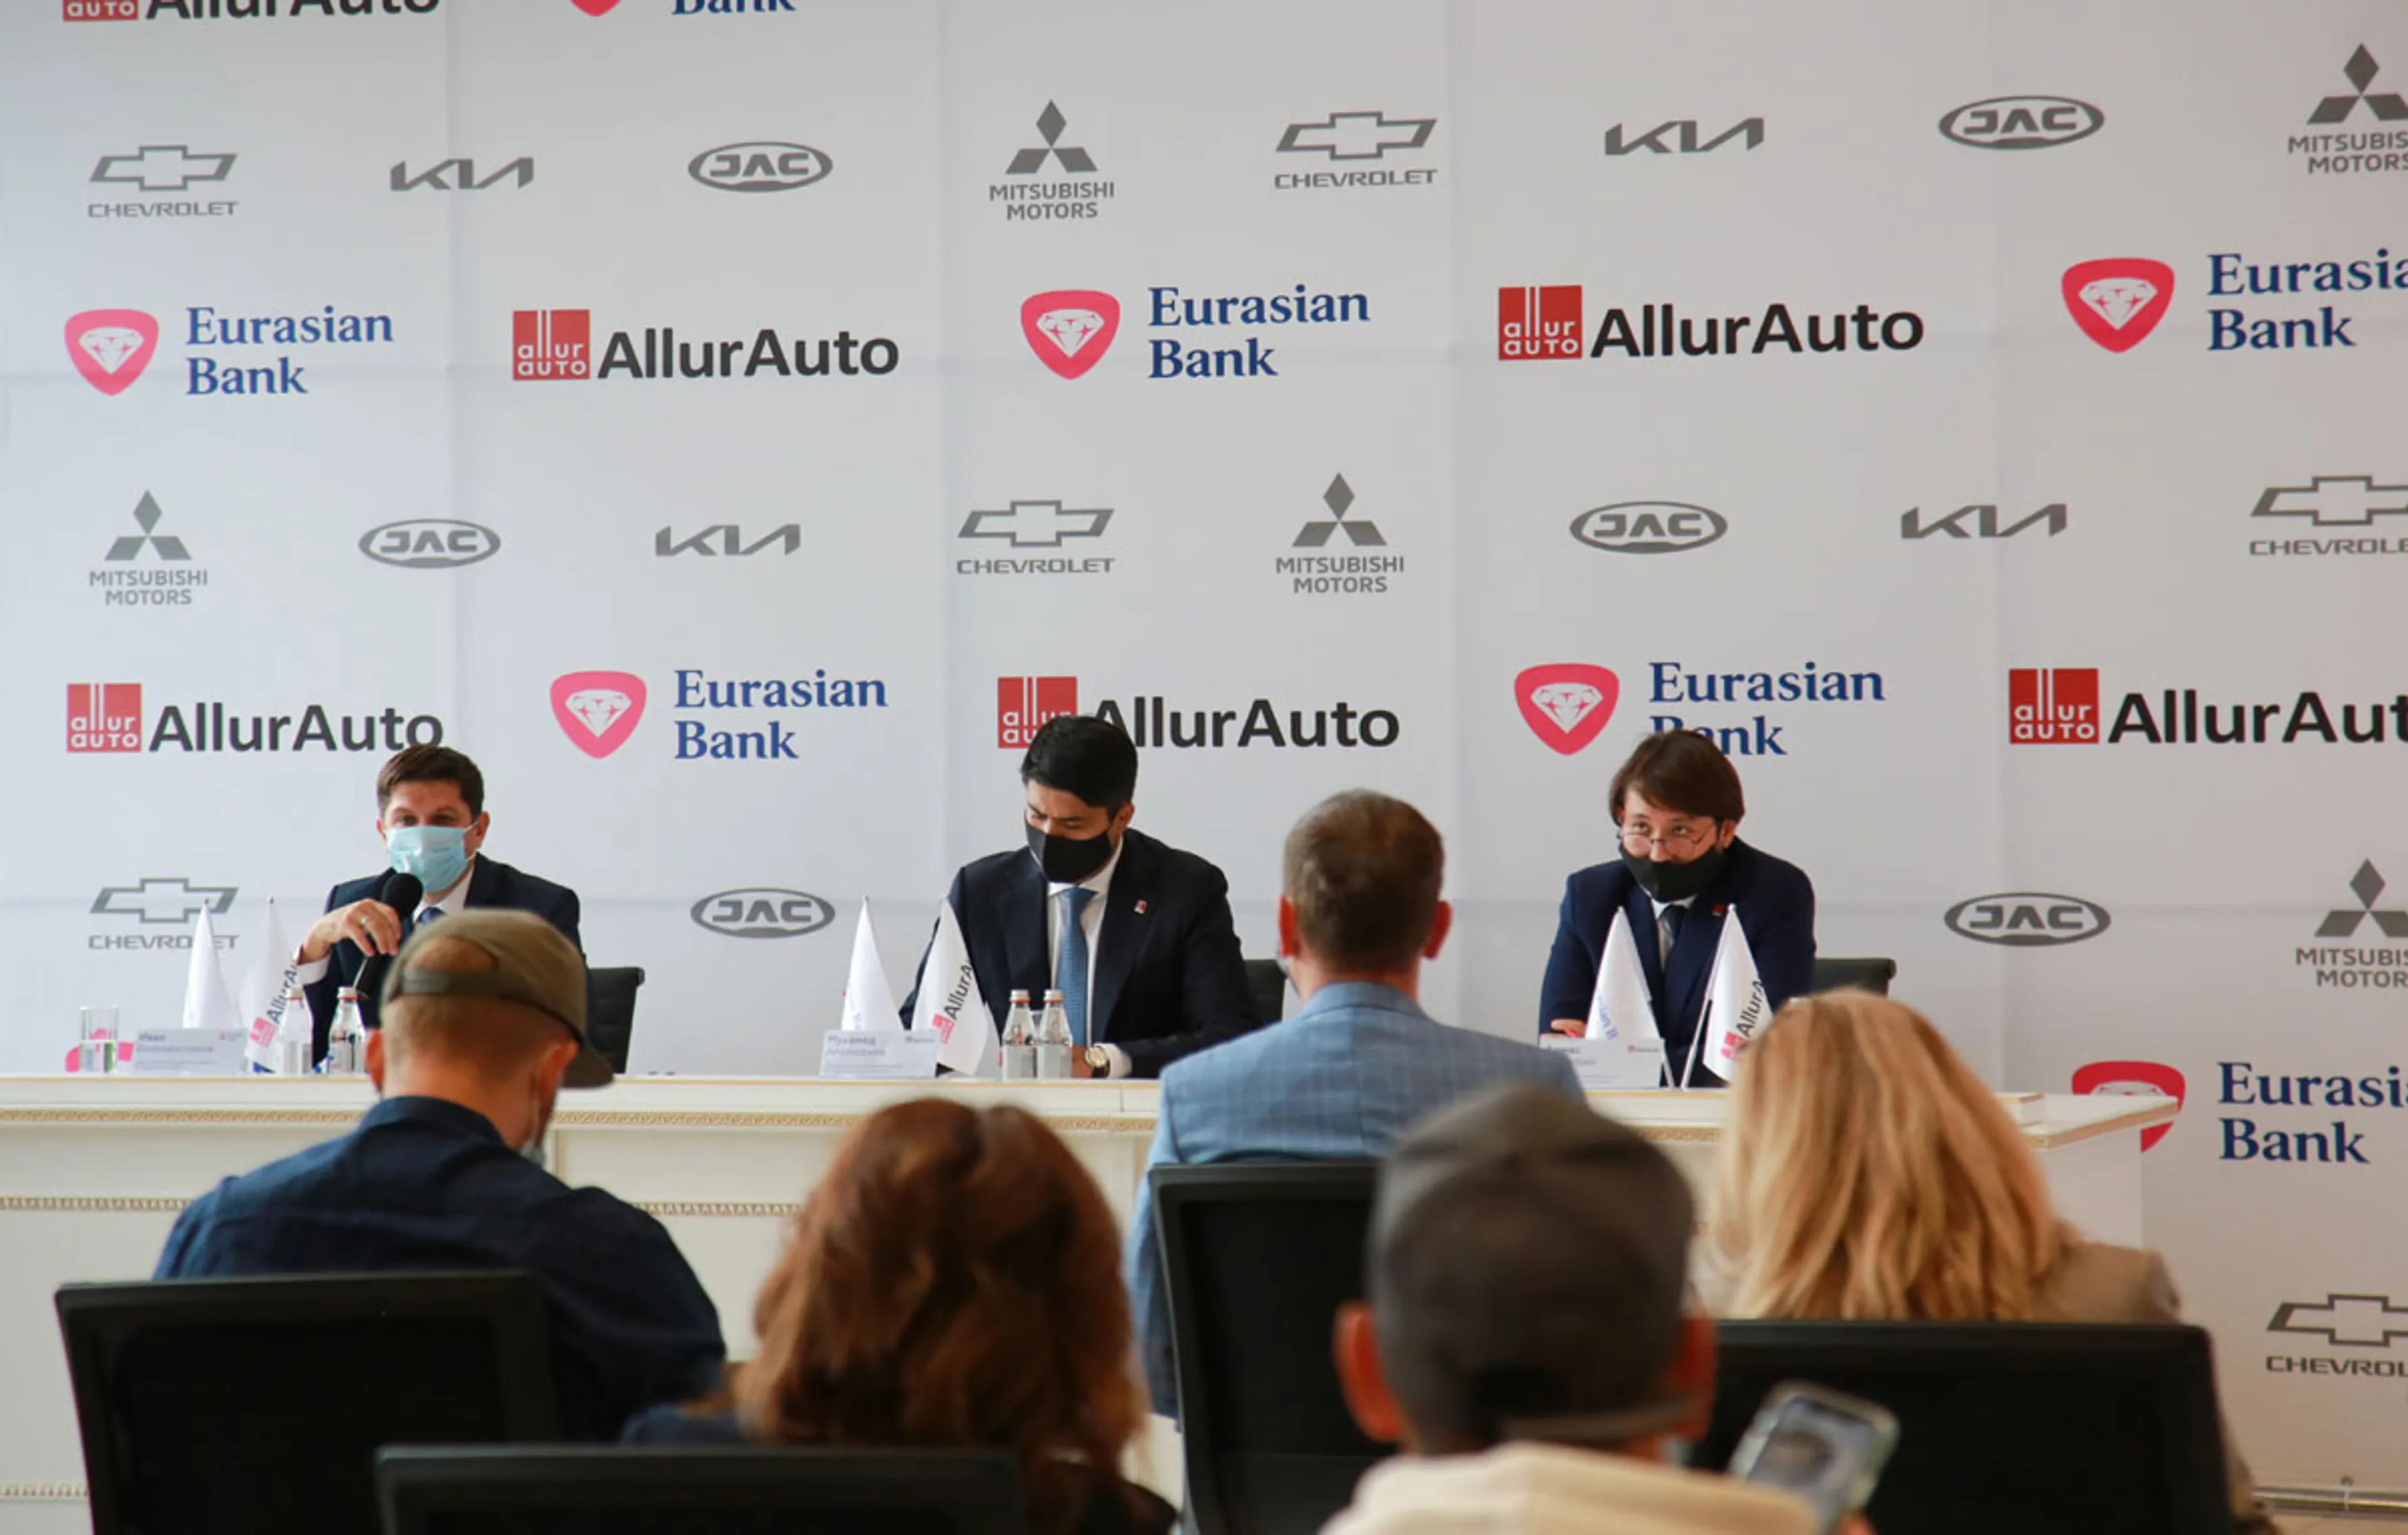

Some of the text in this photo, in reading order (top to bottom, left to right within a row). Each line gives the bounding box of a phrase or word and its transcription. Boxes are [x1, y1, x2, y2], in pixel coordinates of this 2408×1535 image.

[1963, 105, 2078, 135] JAC
[709, 152, 810, 178] JAC
[989, 181, 1114, 201] MITSUBISHI
[1274, 169, 1437, 189] CHEVROLET
[88, 201, 238, 218] CHEVROLET
[1006, 203, 1098, 221] MOTORS
[1149, 284, 1370, 326] Eurasian
[187, 305, 393, 345] Eurasian
[1590, 303, 1924, 358] AllurAuto
[2208, 306, 2355, 351] Bank
[597, 327, 899, 379] AllurAuto
[1149, 337, 1278, 378] Bank
[187, 356, 307, 394] Bank
[1593, 512, 1703, 538] JAC
[379, 529, 479, 554] JAC
[89, 569, 208, 587] MITSUBISHI
[956, 557, 1115, 574] CHEVROLET
[1275, 556, 1404, 574] MITSUBISHI
[105, 588, 193, 606] MOTORS
[1294, 576, 1388, 594] MOTORS
[674, 668, 887, 708] Eurasian
[1649, 661, 1885, 703] Eurasian
[149, 702, 443, 752] AllurAuto
[674, 720, 798, 759] Bank
[712, 899, 812, 923] JAC
[1968, 904, 2085, 931] JAC
[88, 932, 240, 951] CHEVROET
[2219, 1117, 2369, 1163] Bank
